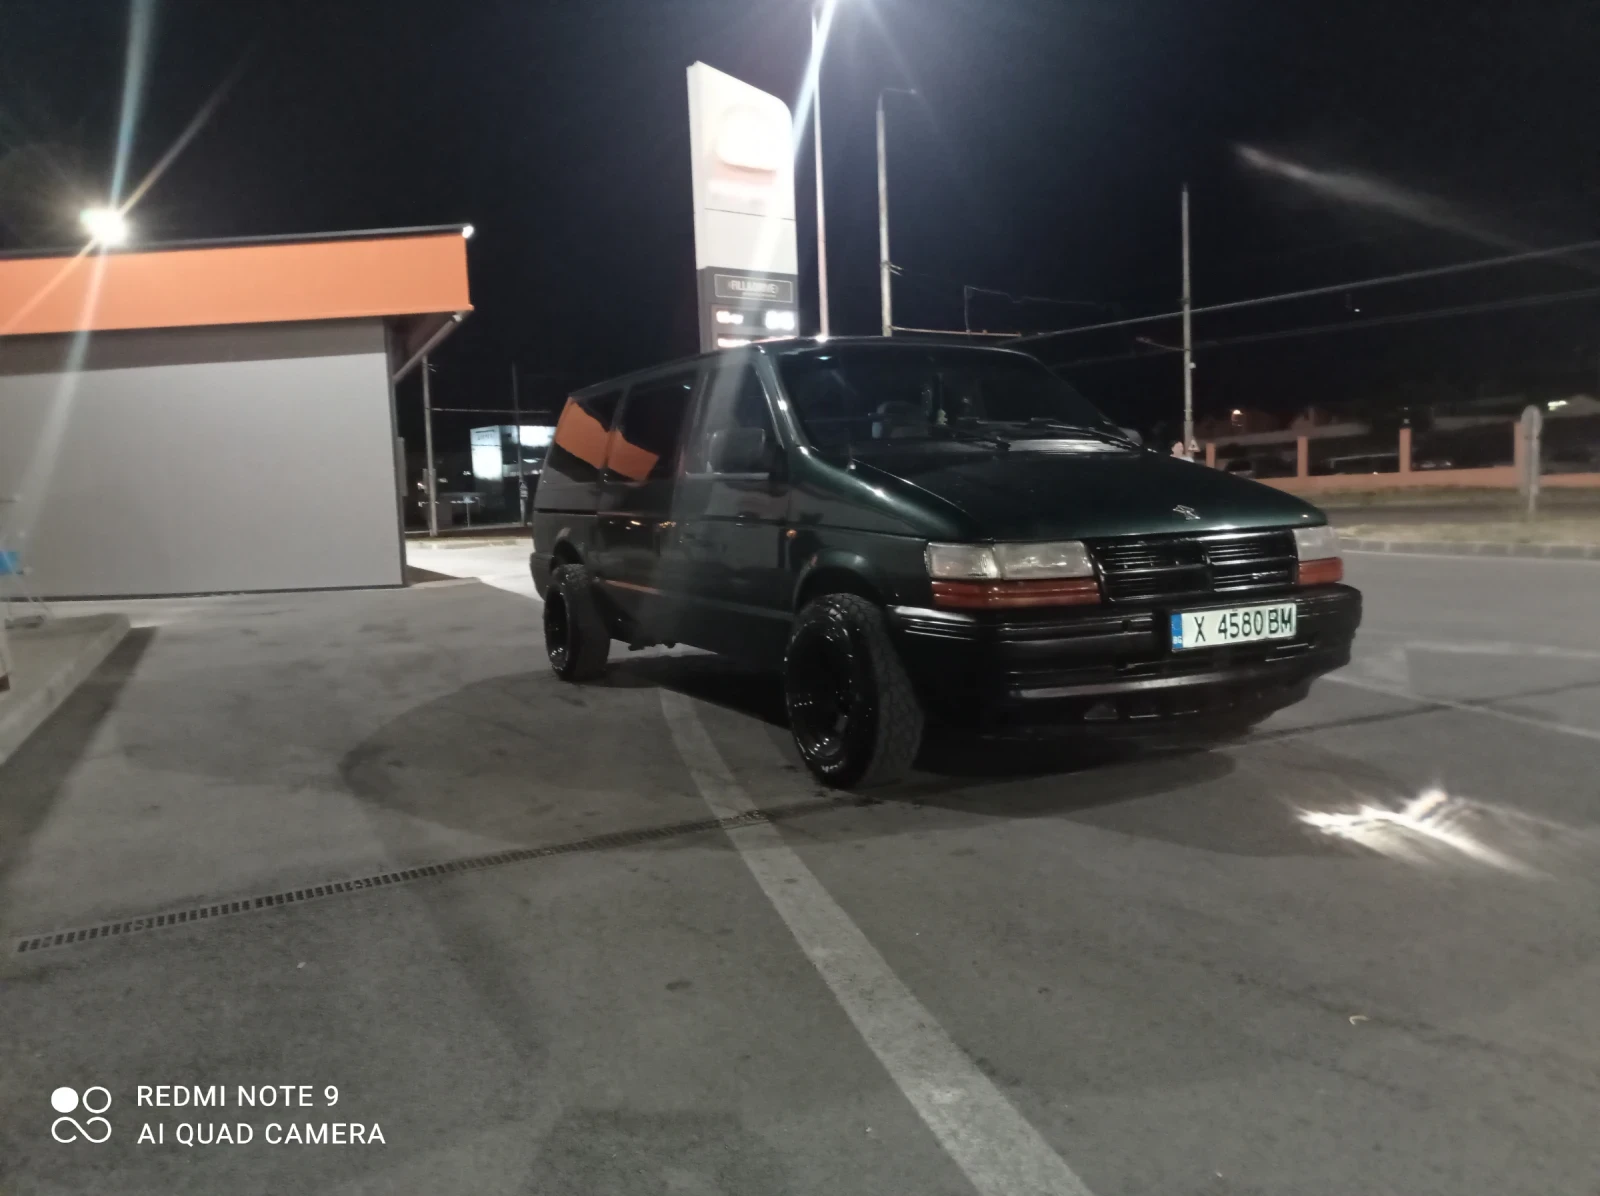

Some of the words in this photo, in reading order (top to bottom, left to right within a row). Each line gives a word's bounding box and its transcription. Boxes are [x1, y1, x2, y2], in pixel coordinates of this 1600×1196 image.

[1193, 616, 1206, 643] X
[1217, 610, 1264, 640] 4580
[1267, 607, 1293, 634] BM
[1172, 636, 1183, 645] BG
